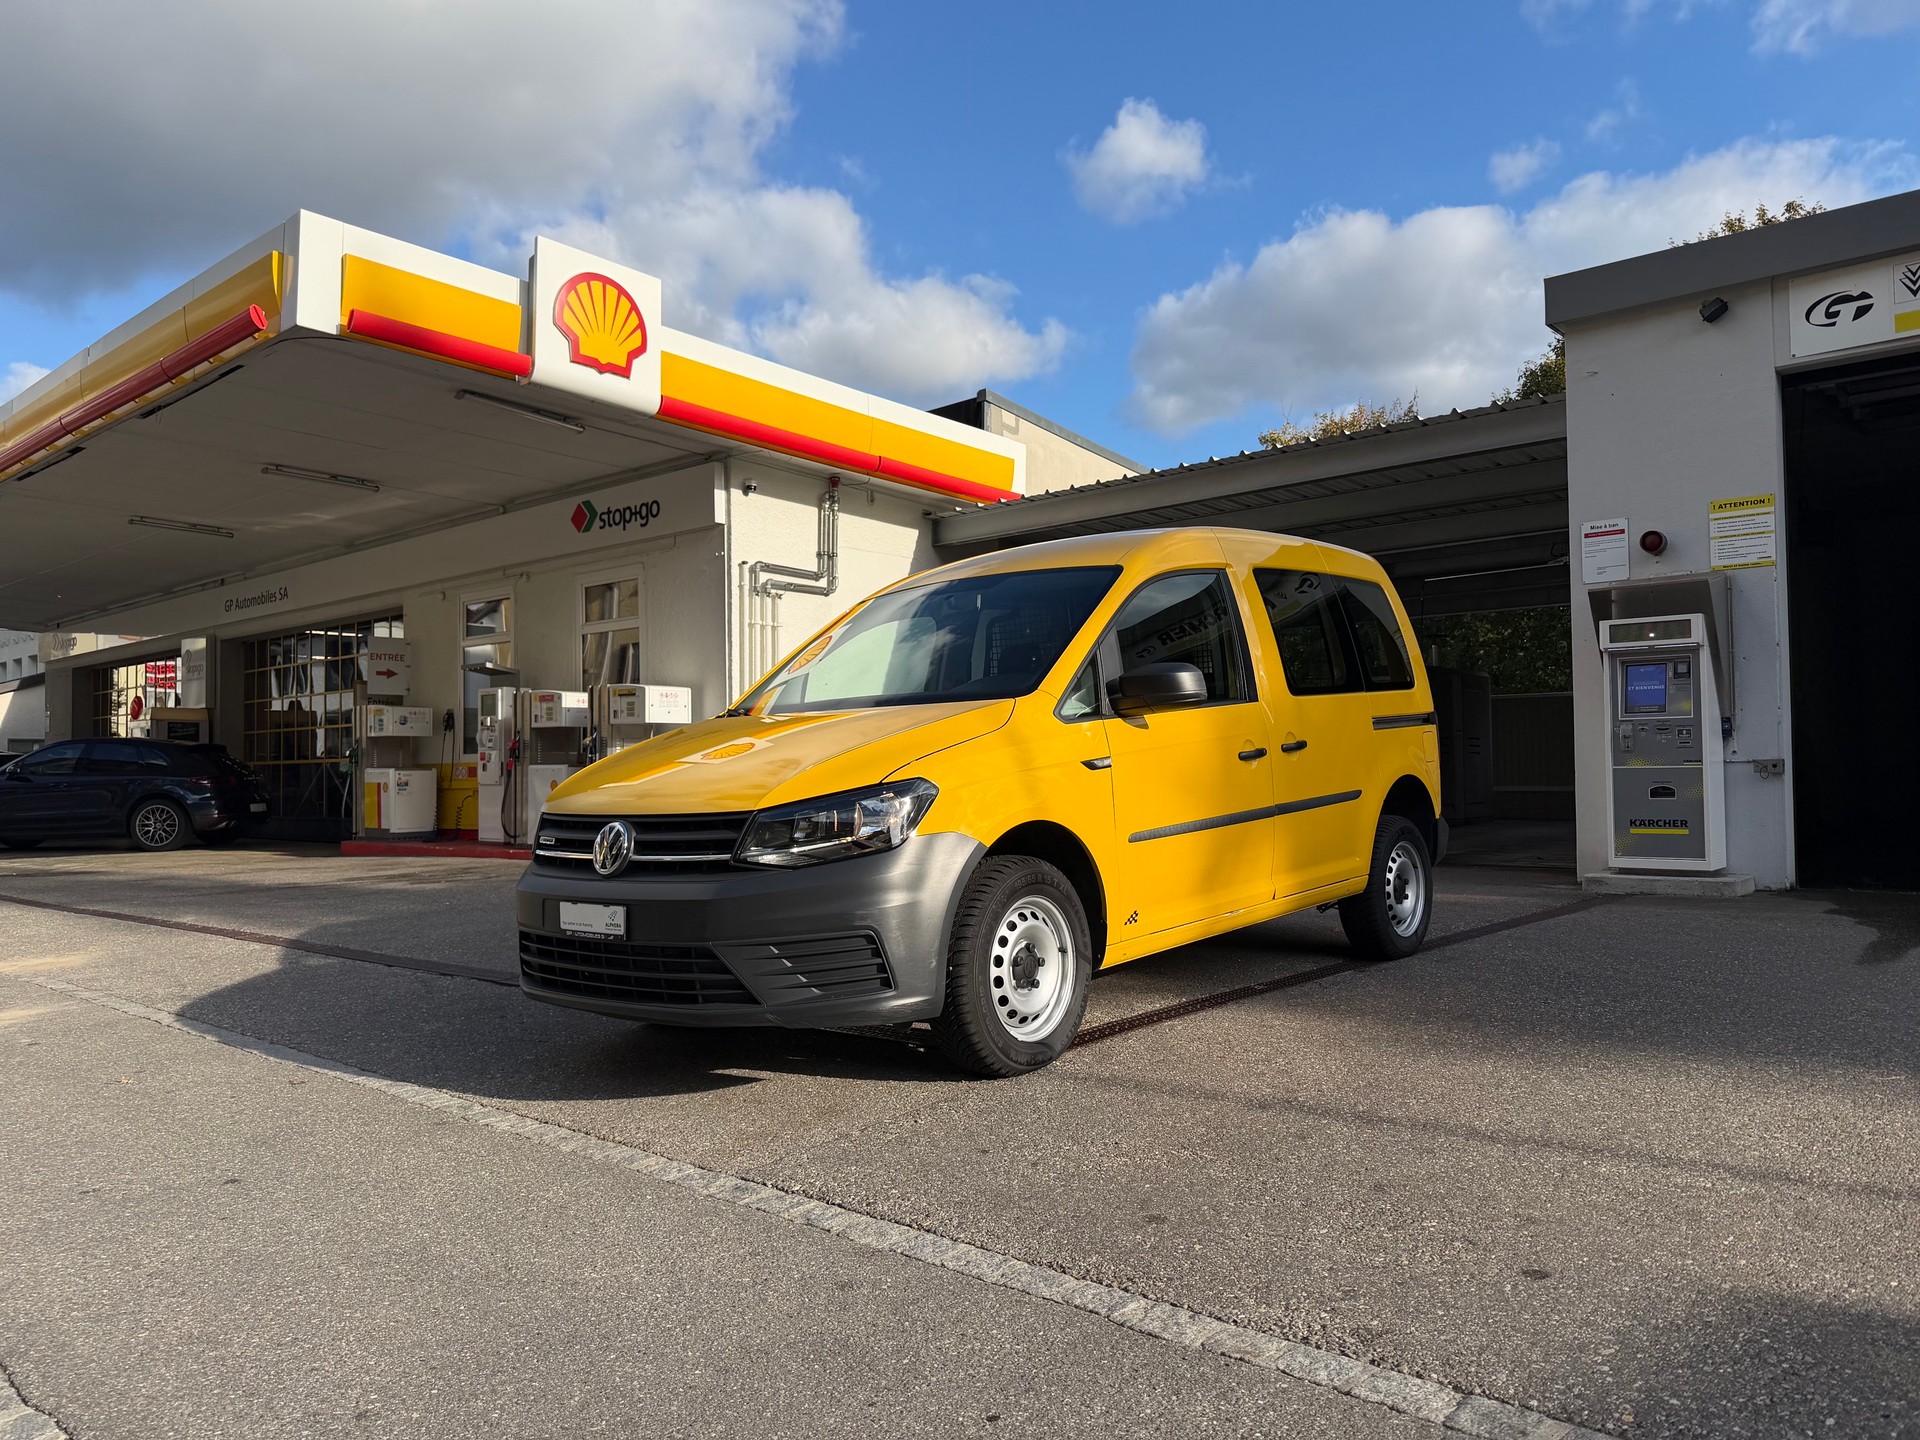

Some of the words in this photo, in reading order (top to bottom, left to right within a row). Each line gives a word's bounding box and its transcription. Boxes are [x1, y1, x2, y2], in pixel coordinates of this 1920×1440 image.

[1717, 498, 1766, 510] ATTENTION
[599, 499, 661, 531] stop+go
[224, 599, 234, 612] GP
[234, 589, 277, 611] Automobiles
[278, 586, 289, 601] SA
[370, 652, 405, 662] ENTRÉE
[1629, 818, 1689, 828] KÄRCHER
